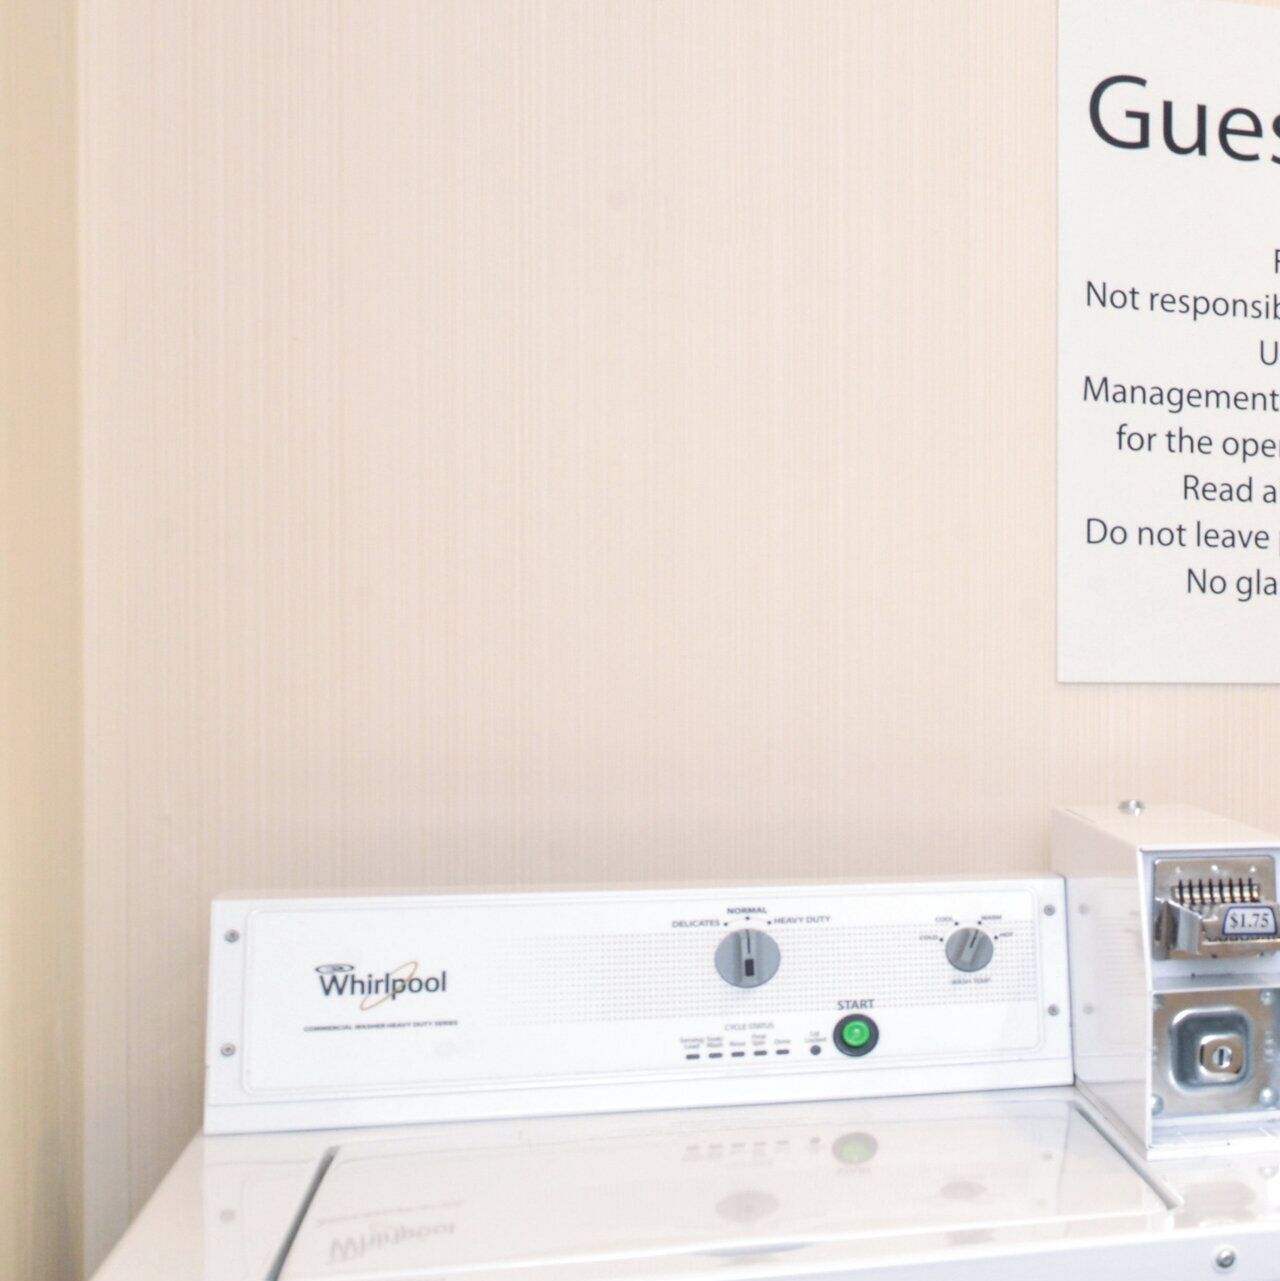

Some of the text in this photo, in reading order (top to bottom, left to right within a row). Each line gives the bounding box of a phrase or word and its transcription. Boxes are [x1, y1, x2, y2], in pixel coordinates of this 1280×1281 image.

[1087, 280, 1139, 311] Not
[1083, 376, 1279, 414] Management
[1116, 423, 1157, 452] for
[1165, 426, 1213, 455] the
[1183, 474, 1253, 503] Read
[1087, 518, 1128, 545] Do
[1138, 524, 1186, 547] not
[1196, 520, 1270, 549] leave
[1187, 568, 1227, 595] No
[671, 919, 721, 929] DELICATES
[726, 906, 768, 915] NORMAL
[773, 914, 831, 925] HEAVY DUTY
[1229, 911, 1270, 929] $1.75
[319, 970, 447, 1001] Whirlpool
[837, 998, 875, 1011] START
[724, 1021, 775, 1032] CYCLE STATUS
